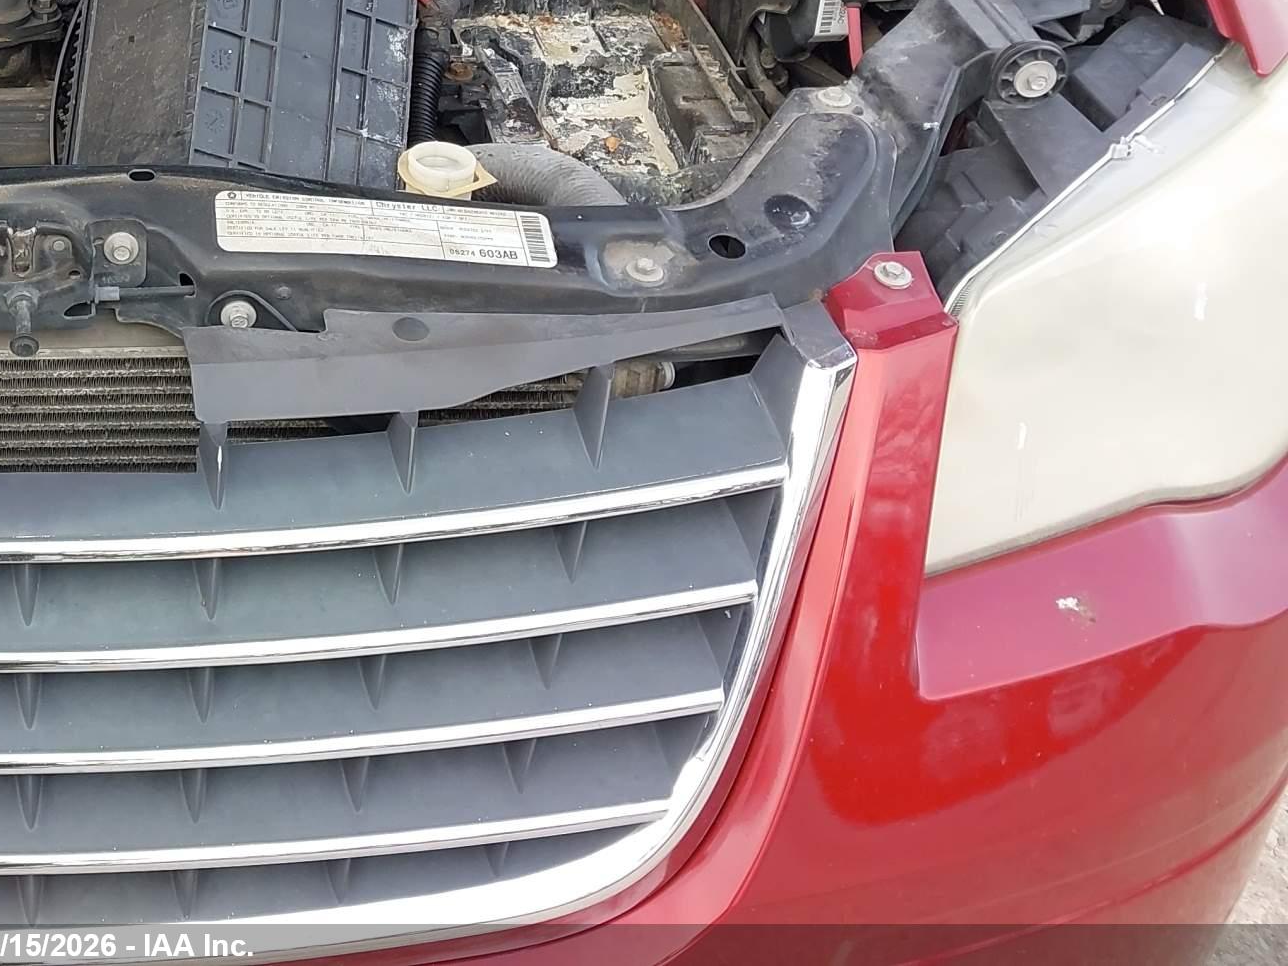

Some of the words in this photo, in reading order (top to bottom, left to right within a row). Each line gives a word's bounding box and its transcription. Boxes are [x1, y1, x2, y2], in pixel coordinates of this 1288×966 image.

[375, 201, 416, 211] Chrysler
[421, 204, 438, 212] LLC
[479, 248, 518, 260] 603AB
